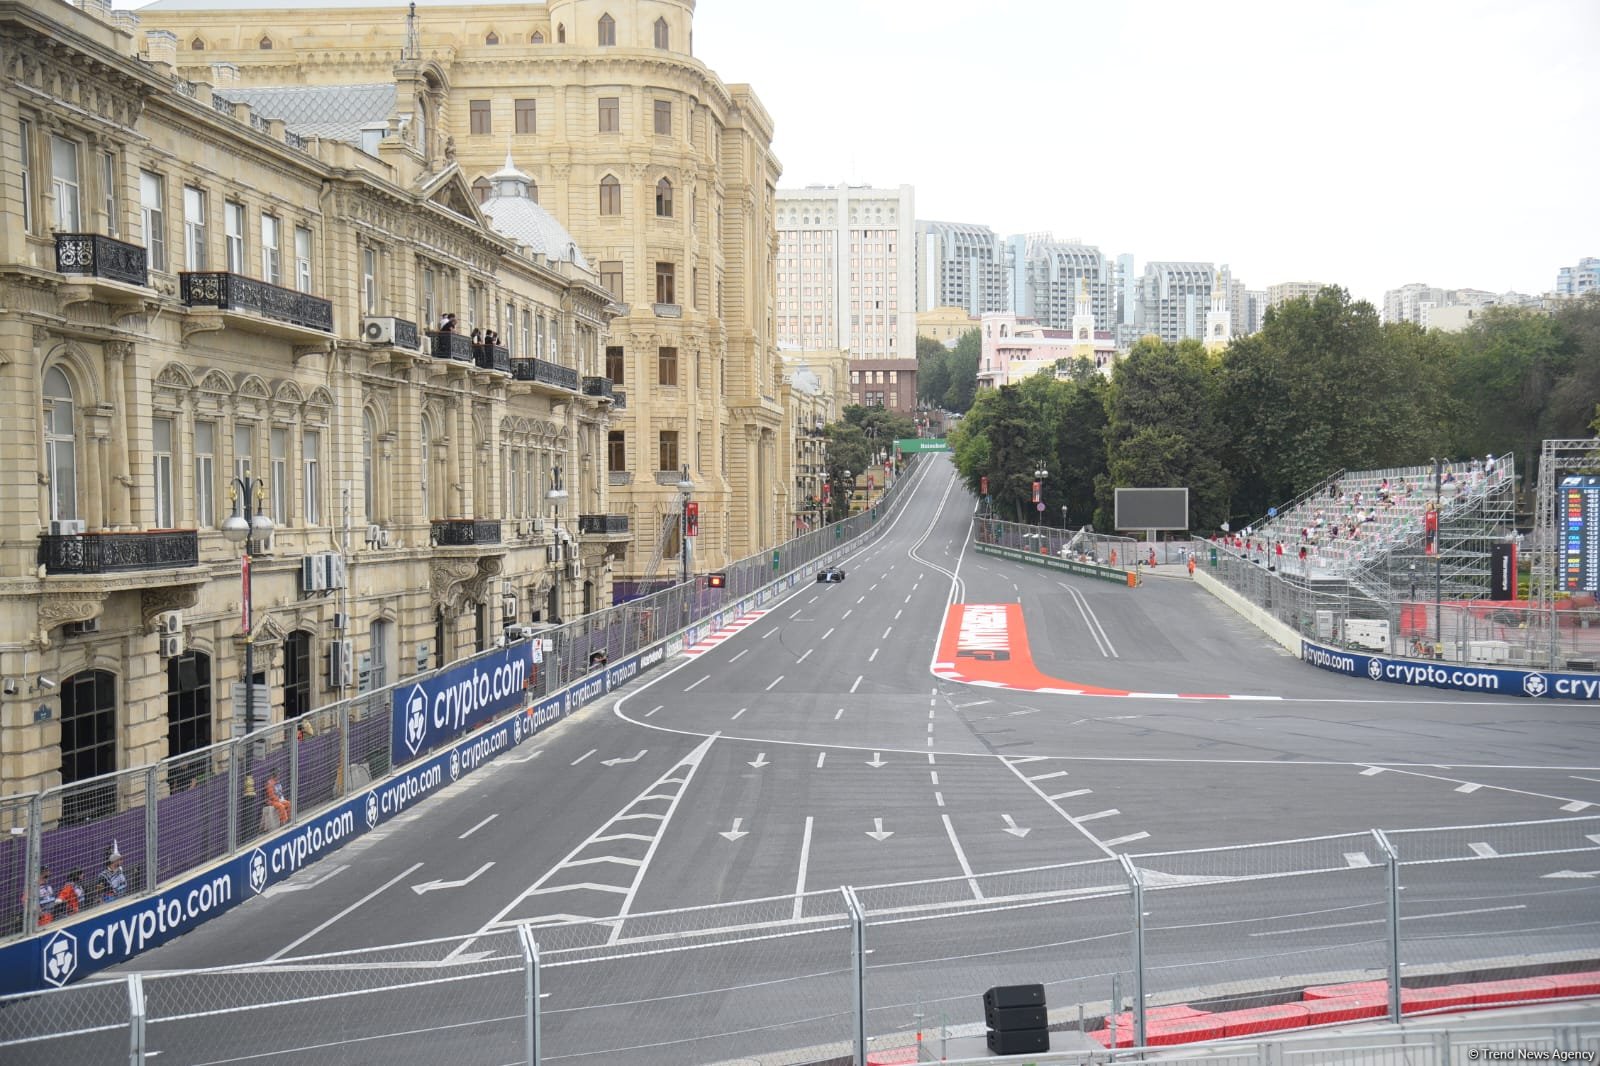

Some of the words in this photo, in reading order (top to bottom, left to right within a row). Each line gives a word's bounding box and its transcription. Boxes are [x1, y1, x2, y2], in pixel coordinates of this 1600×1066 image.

[611, 661, 637, 685] crypto.com
[1308, 648, 1354, 671] crypto.com
[1386, 664, 1498, 689] crypto.com
[433, 658, 525, 731] crypto.com
[571, 678, 602, 706] crypto.com
[1555, 679, 1600, 698] cry
[461, 728, 508, 769] crypto.com
[381, 763, 442, 813] crypto.com
[271, 809, 354, 873] crypto.com
[88, 873, 231, 960] crypto.com
